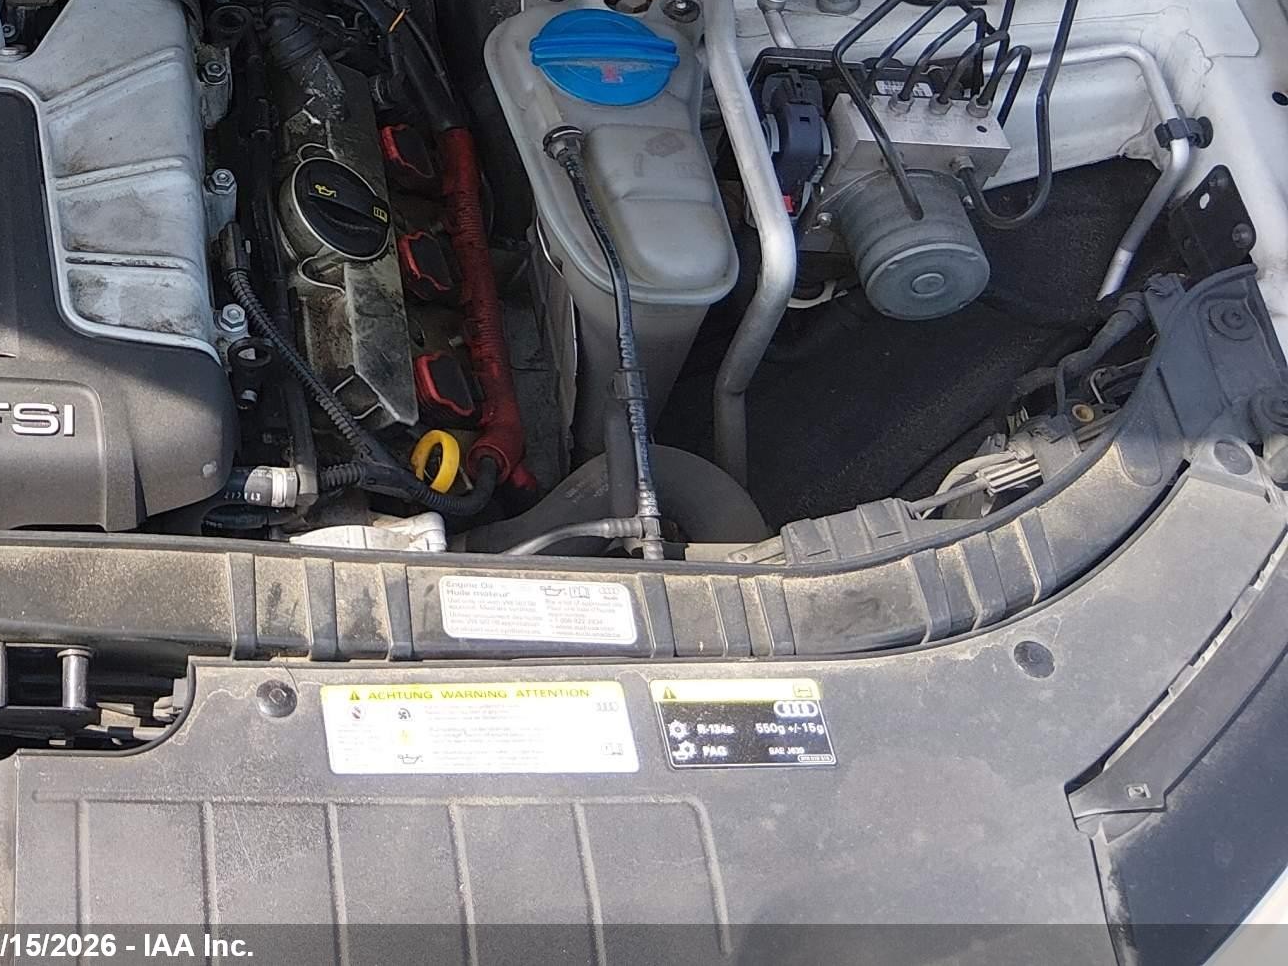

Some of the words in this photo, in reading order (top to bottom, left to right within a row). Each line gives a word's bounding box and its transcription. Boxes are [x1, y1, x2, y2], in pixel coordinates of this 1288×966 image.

[368, 689, 433, 700] ACHTUNG
[440, 689, 507, 699] WARNING
[515, 688, 590, 699] ATTENTION
[696, 723, 735, 734] R-134a
[755, 723, 785, 735] 550g
[702, 745, 728, 757] PAG
